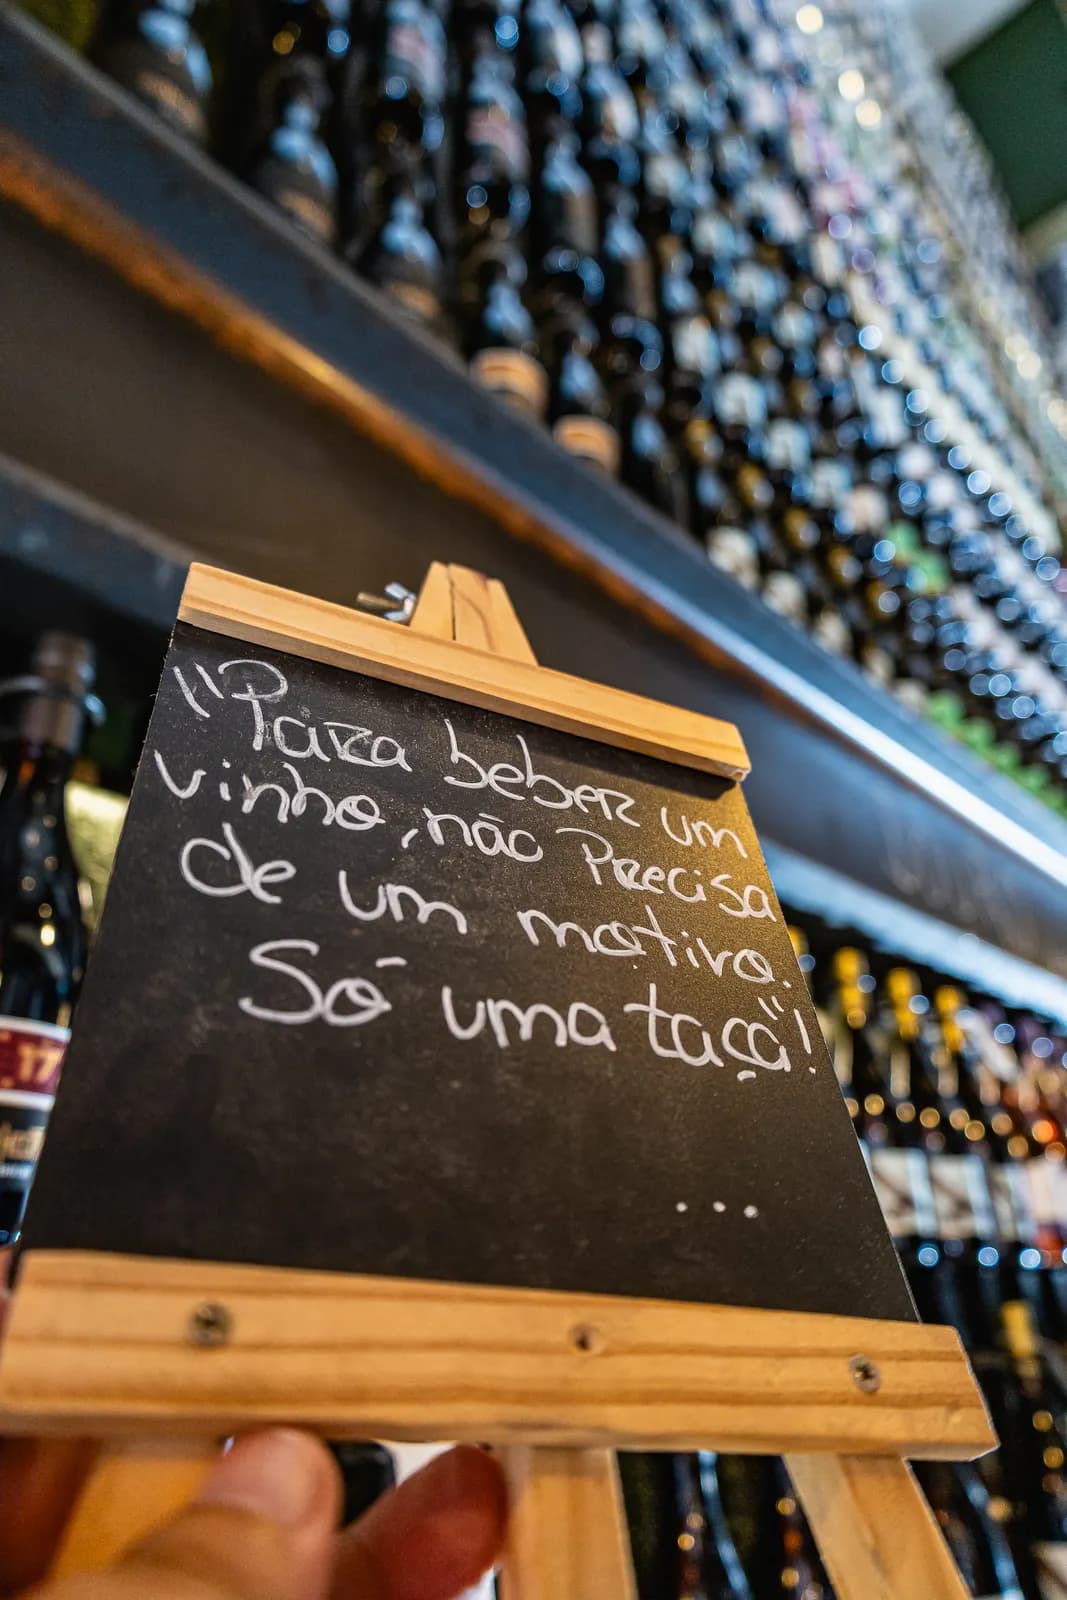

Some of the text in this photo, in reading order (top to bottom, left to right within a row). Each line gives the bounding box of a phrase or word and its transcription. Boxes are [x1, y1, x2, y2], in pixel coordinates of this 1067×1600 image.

[180, 821, 297, 904] de
[338, 869, 468, 935] um
[660, 806, 748, 859] um
[237, 938, 408, 1027] Só
[441, 985, 618, 1052] uma
